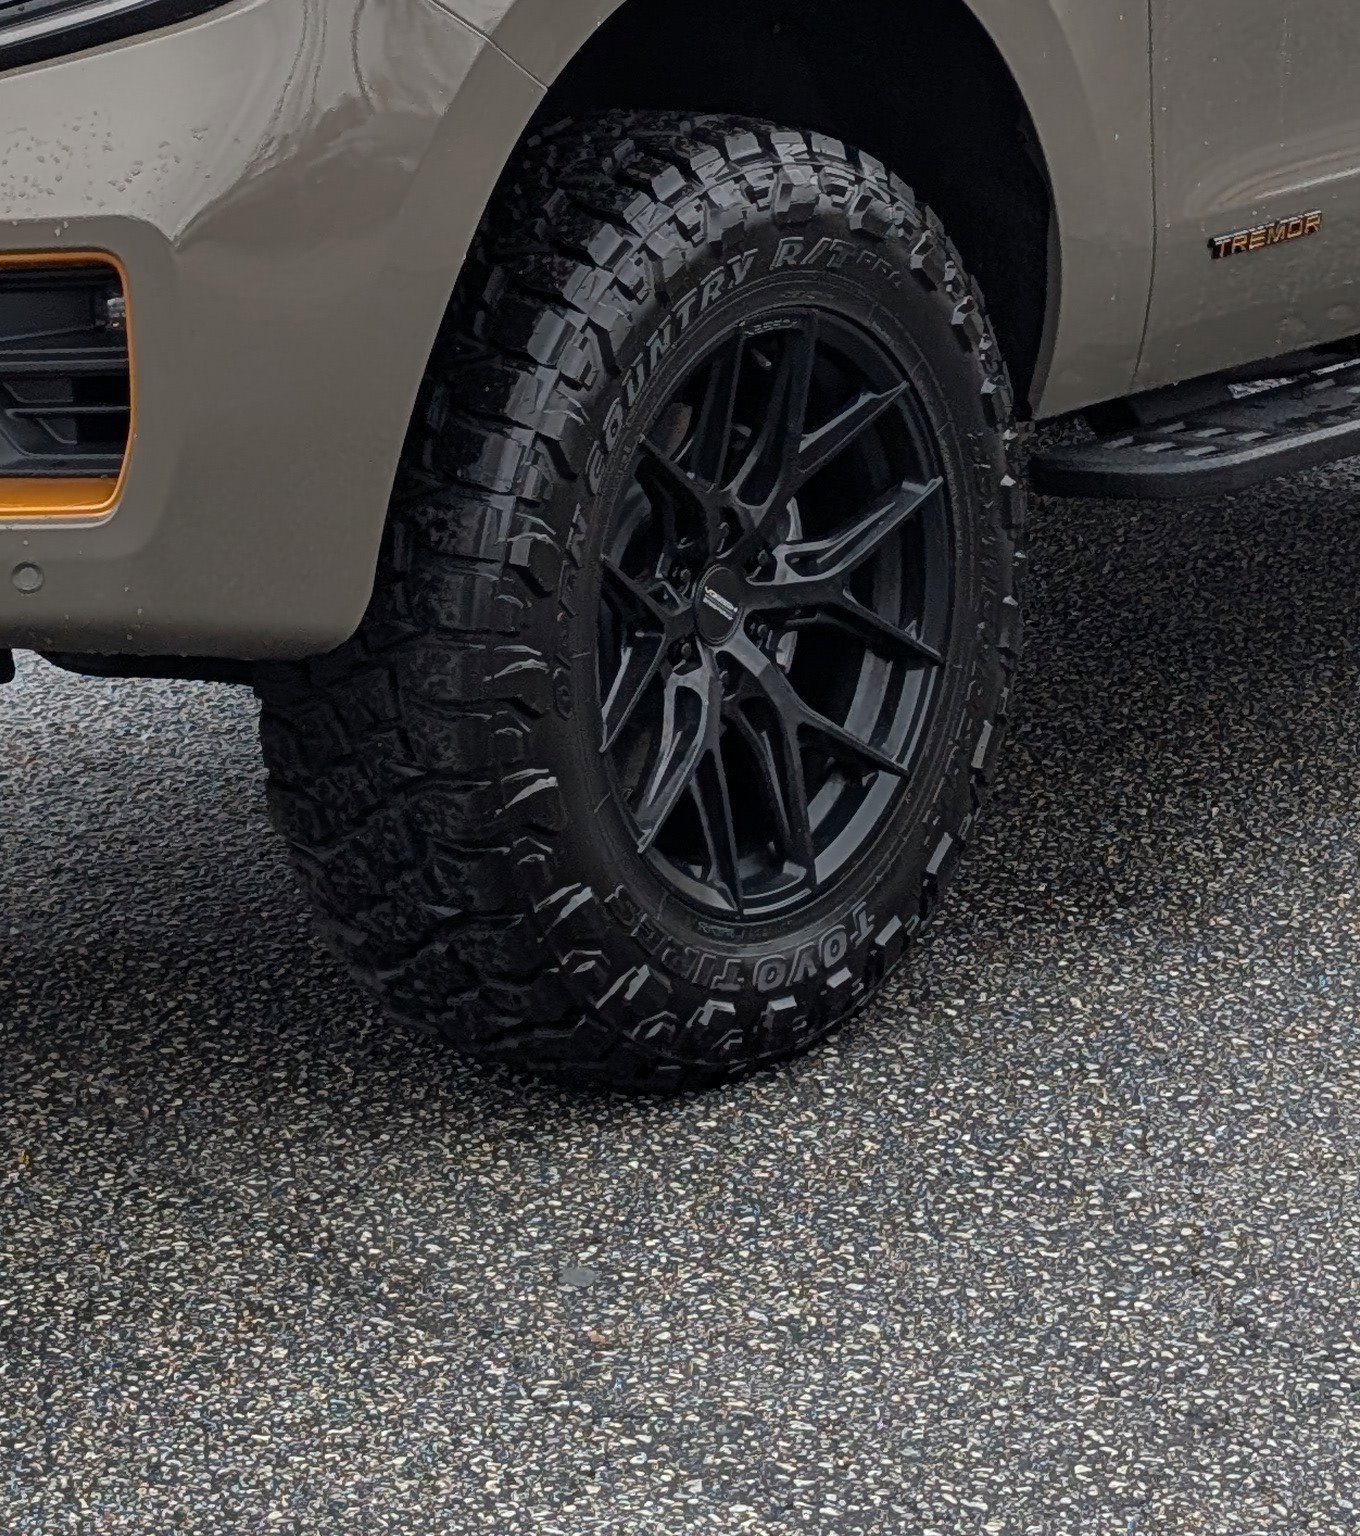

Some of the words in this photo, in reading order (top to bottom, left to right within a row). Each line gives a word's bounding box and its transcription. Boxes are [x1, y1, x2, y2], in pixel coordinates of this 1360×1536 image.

[1207, 209, 1323, 260] TREMOR
[584, 247, 760, 496] COUNTRY
[752, 901, 876, 993] TOYO
